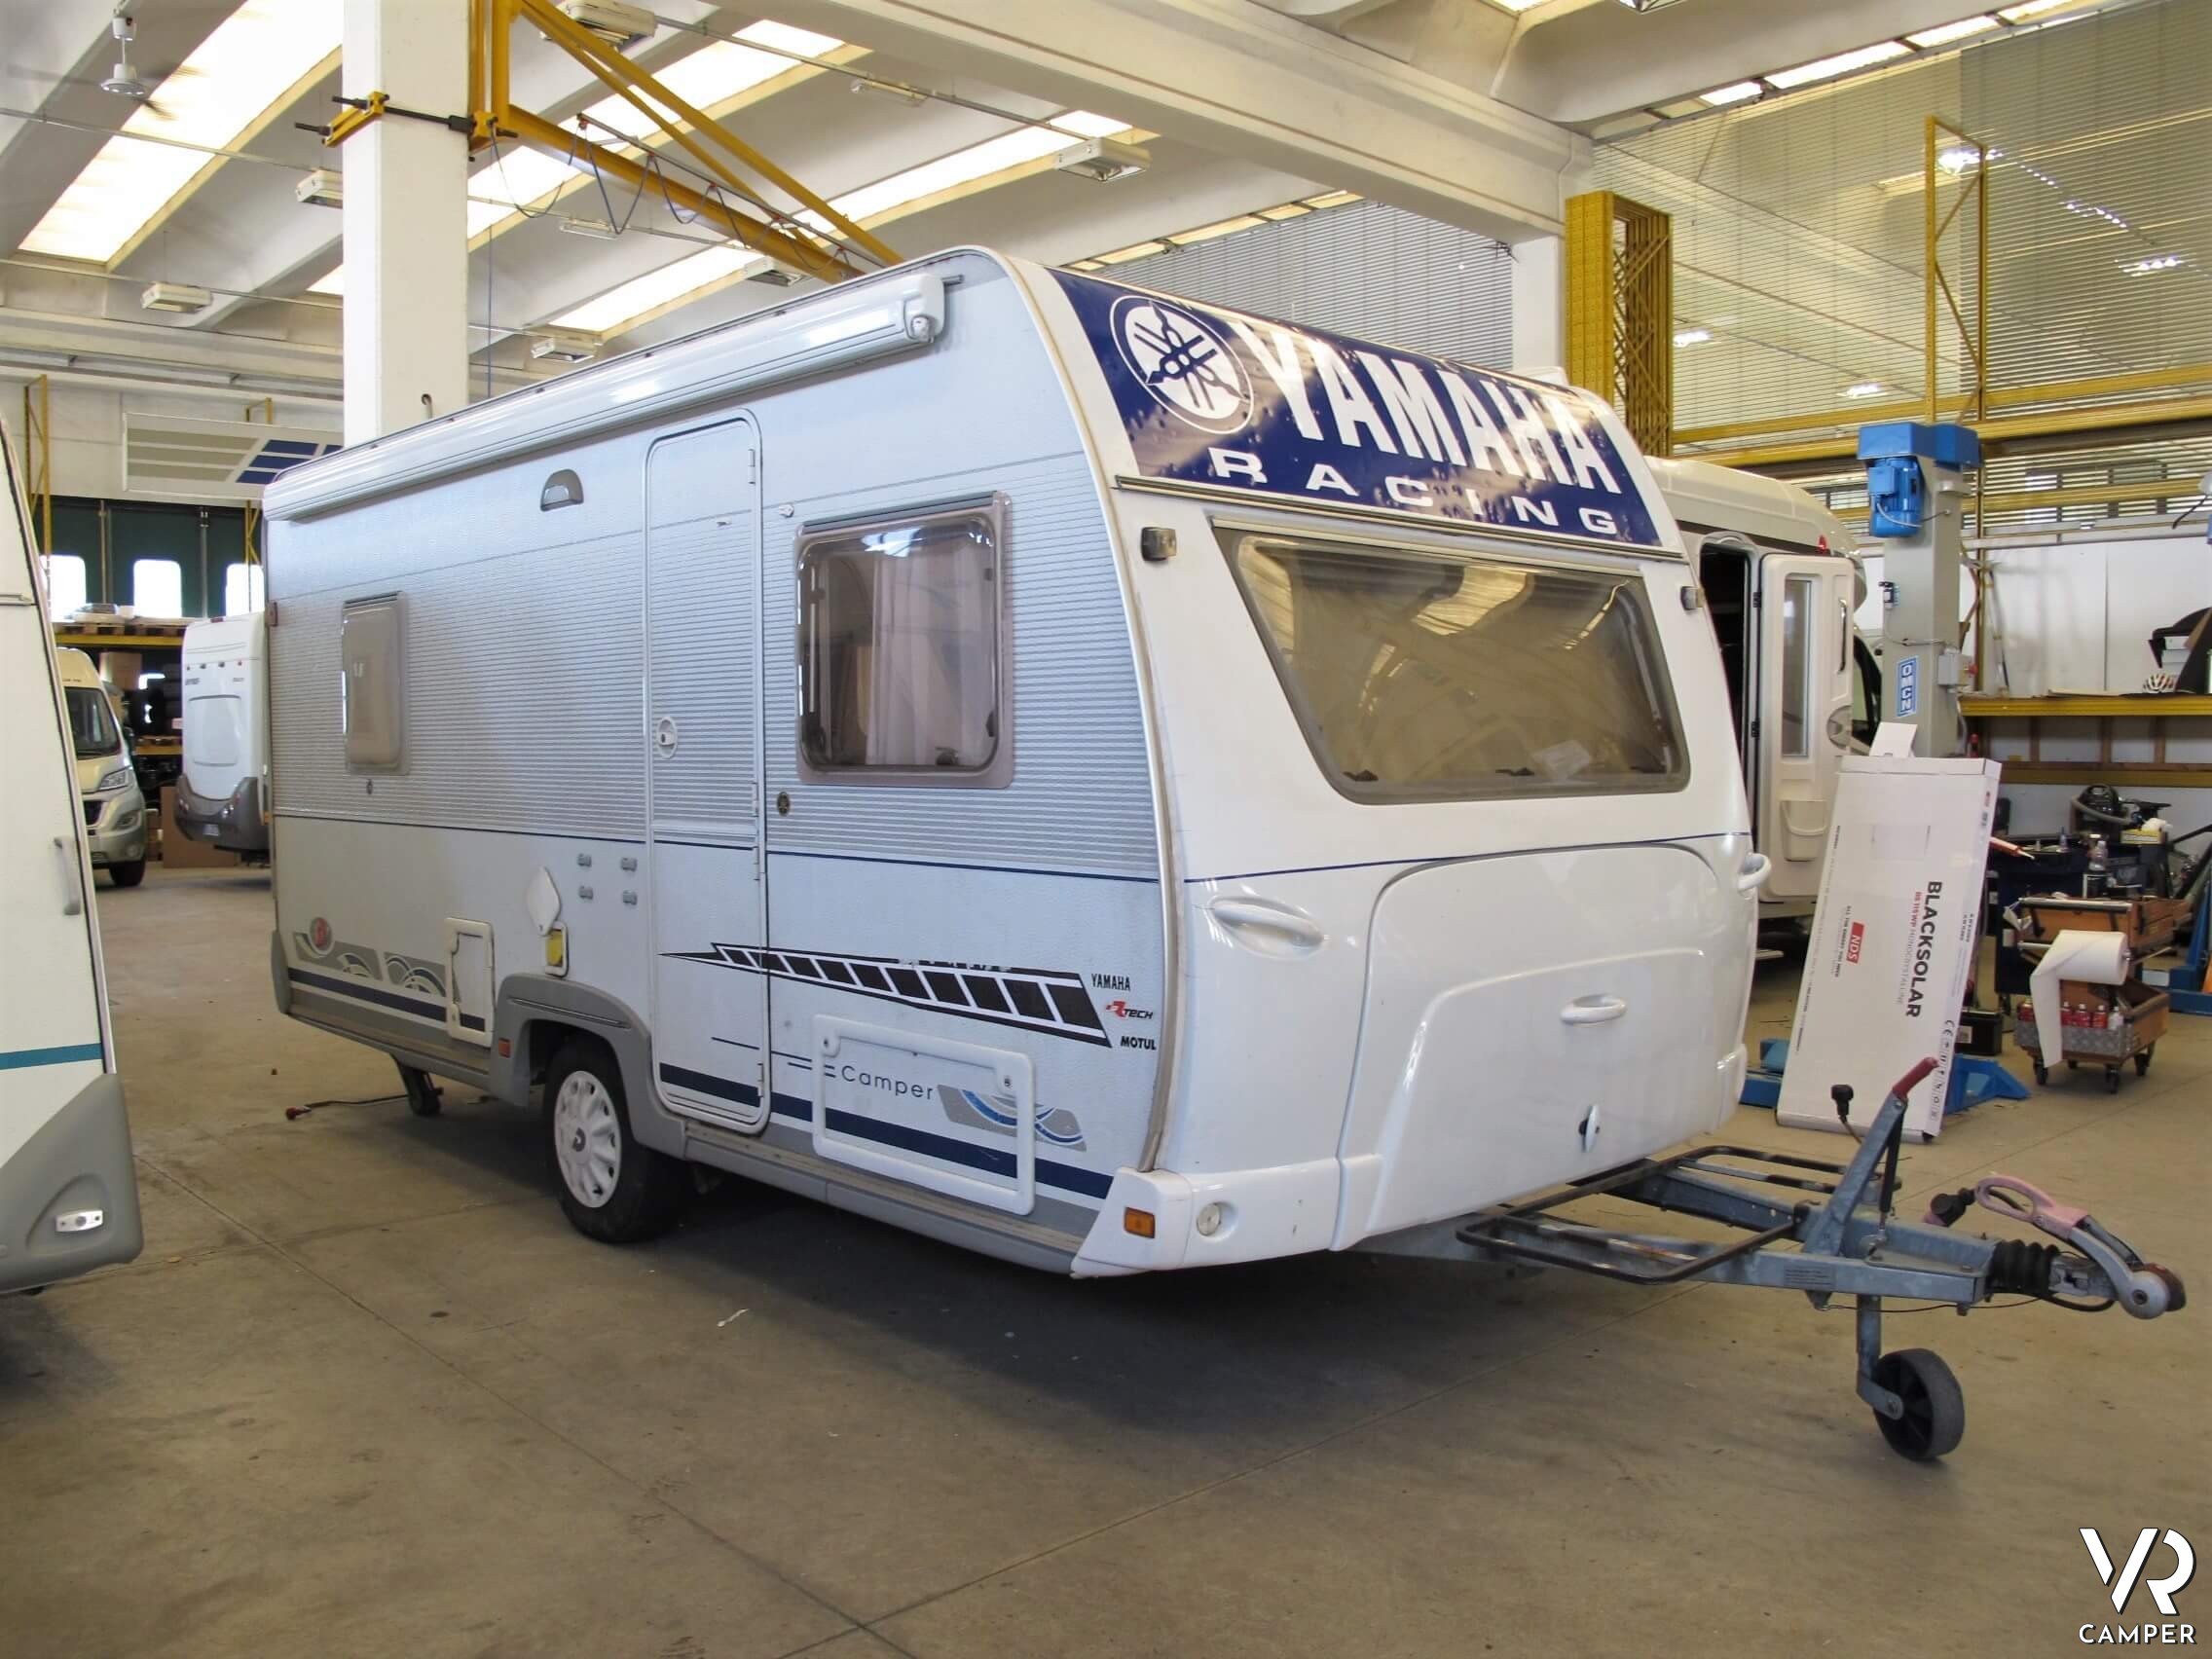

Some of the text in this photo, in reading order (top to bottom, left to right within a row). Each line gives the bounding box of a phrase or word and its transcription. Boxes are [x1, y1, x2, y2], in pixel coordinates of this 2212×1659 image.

[1235, 319, 1622, 495] YAMAHA
[1207, 446, 1618, 535] RACING
[1848, 935, 1862, 961] NDS
[1905, 881, 1943, 1017] BLACKSOLAR
[1091, 974, 1131, 991] YAMAHA
[1121, 1036, 1157, 1051] MOTUL
[841, 1065, 933, 1100] Camper
